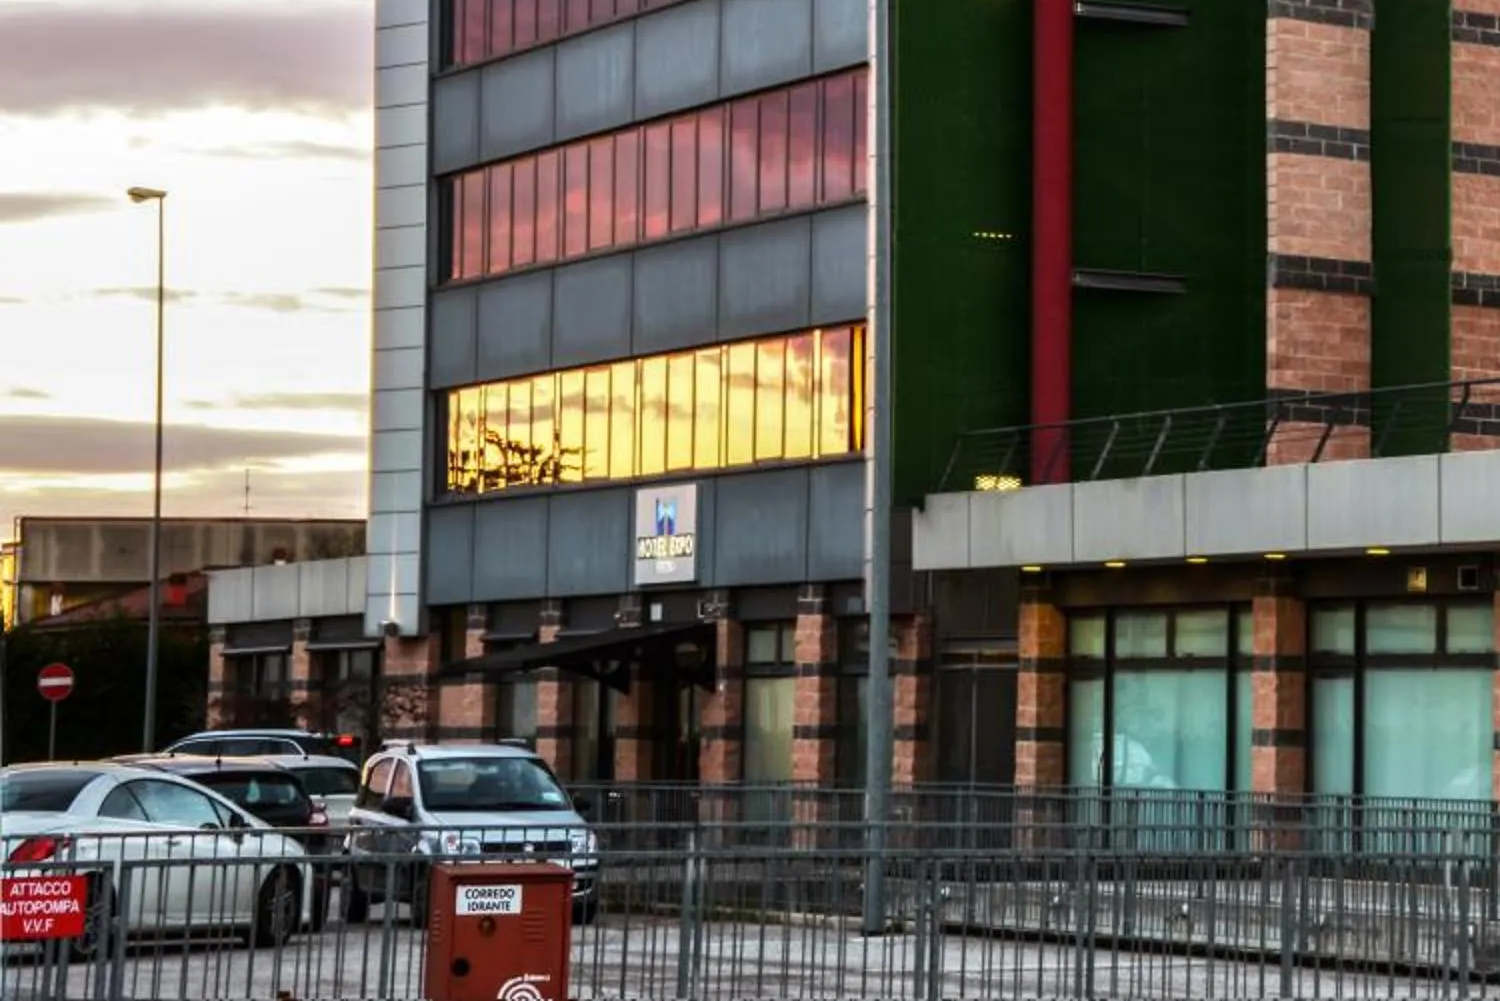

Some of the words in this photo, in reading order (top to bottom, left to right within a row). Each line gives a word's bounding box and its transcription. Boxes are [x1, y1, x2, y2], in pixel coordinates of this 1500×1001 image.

[9, 880, 72, 897] ATTACCO
[464, 887, 515, 900] CORREDO
[0, 898, 81, 917] AUTOPOMPA
[467, 900, 511, 912] IDRANTE
